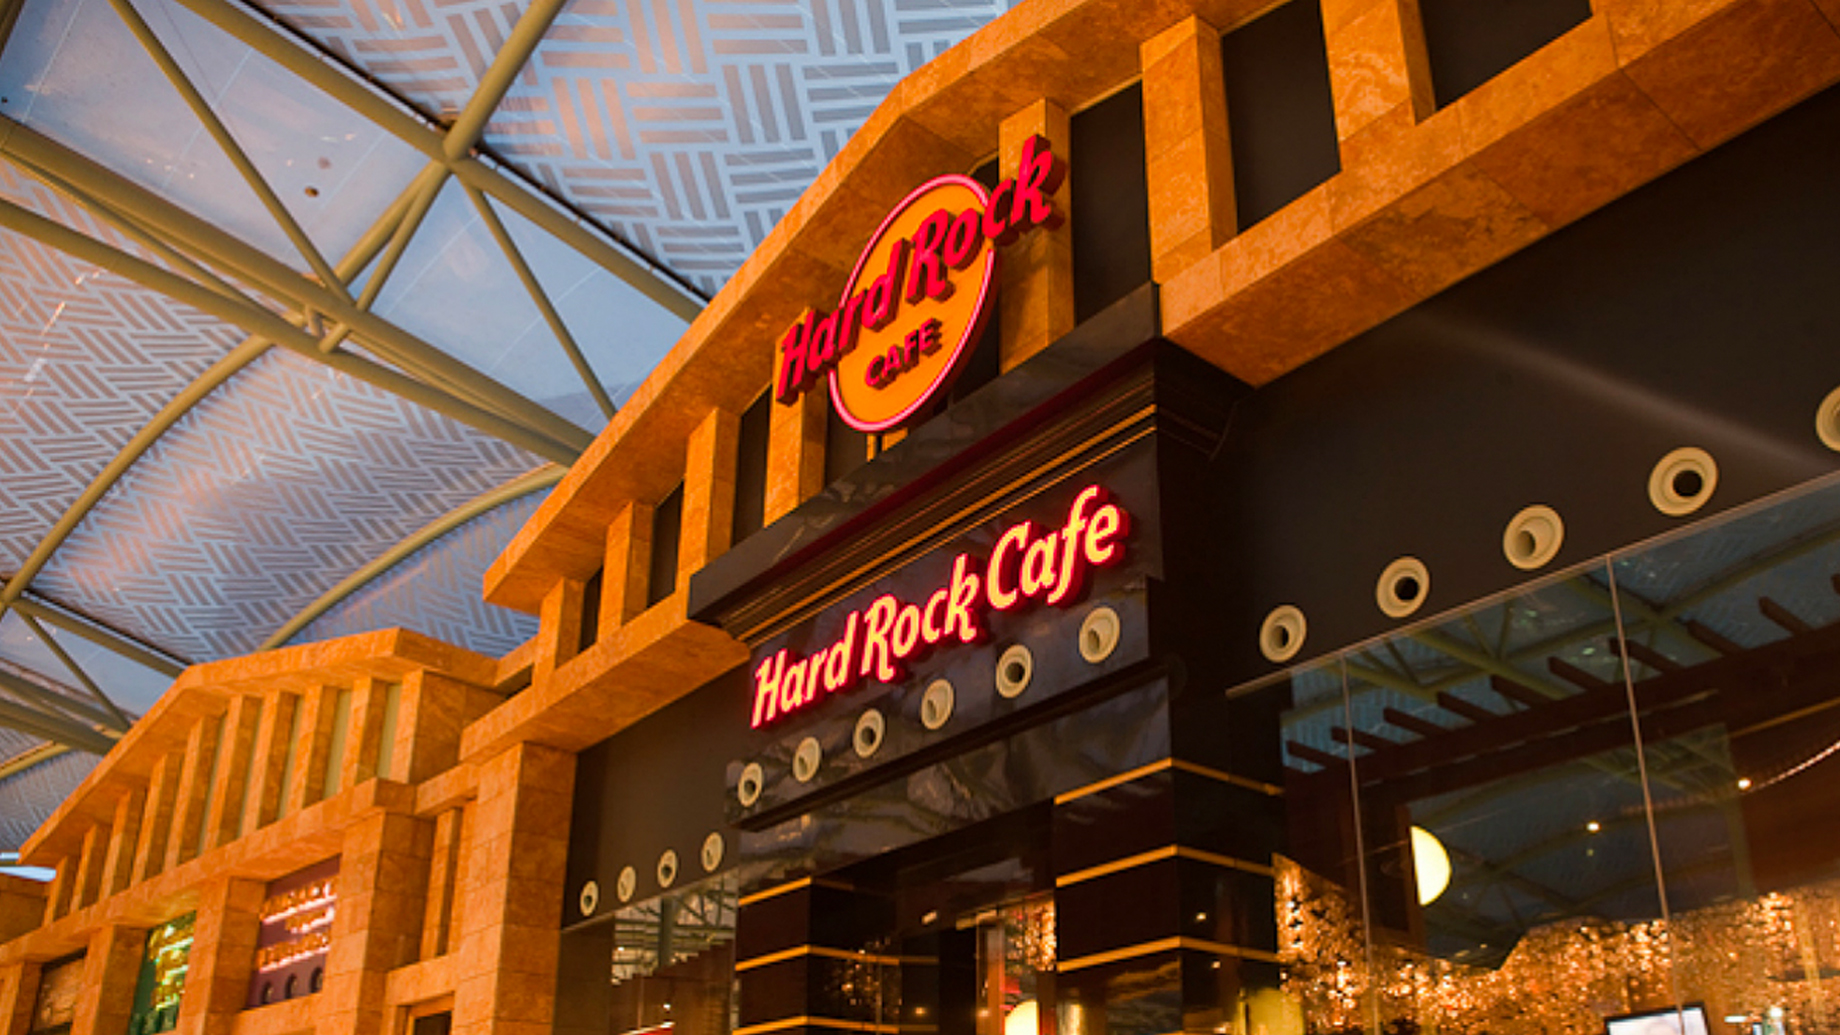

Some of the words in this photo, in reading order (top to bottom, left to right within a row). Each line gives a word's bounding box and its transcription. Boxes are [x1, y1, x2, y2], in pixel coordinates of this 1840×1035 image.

[776, 238, 908, 404] Hard
[905, 134, 1060, 303] Rock
[864, 317, 942, 390] CAFE
[750, 609, 861, 730] Hard
[860, 553, 981, 683] Rock
[985, 484, 1124, 610] Cafe
